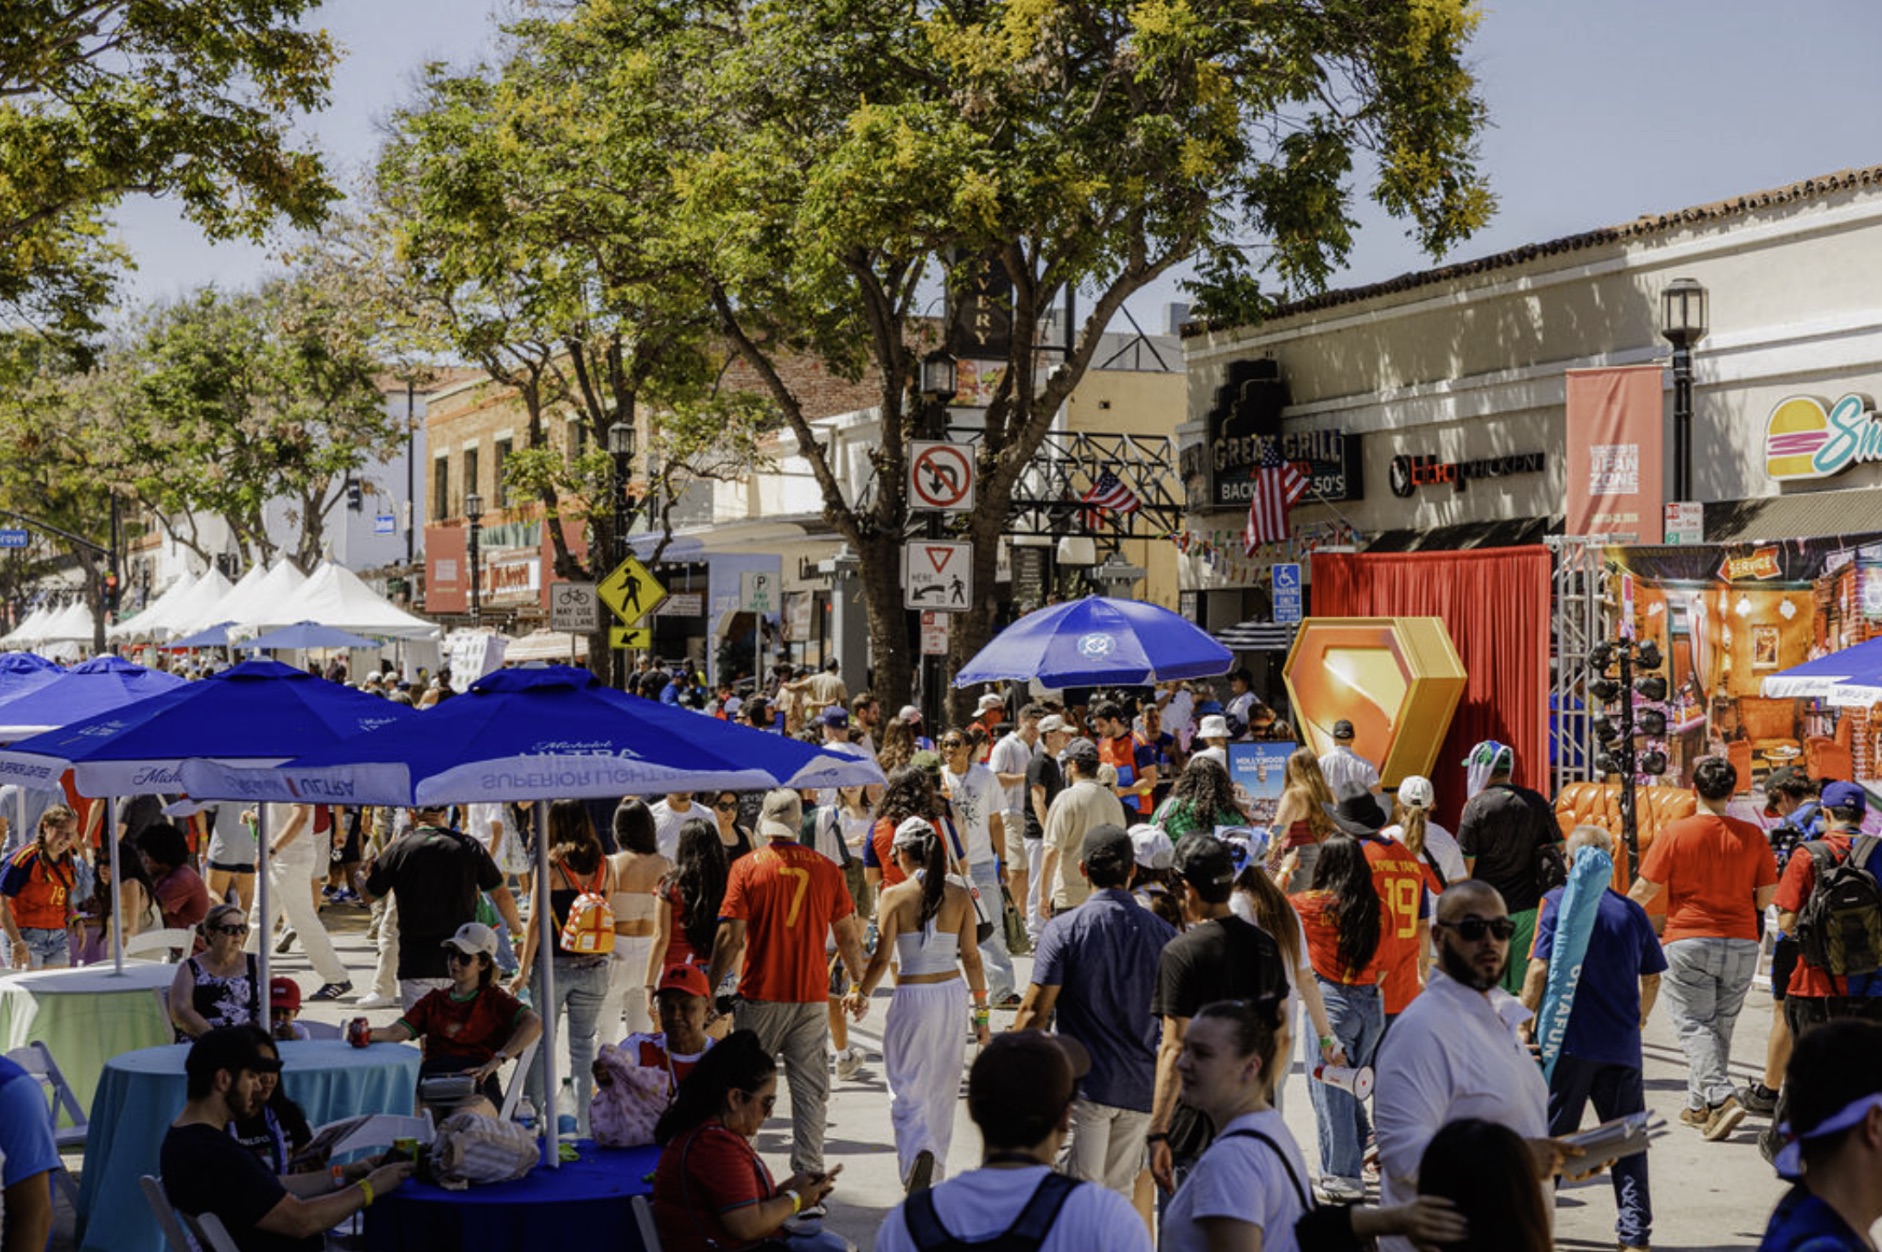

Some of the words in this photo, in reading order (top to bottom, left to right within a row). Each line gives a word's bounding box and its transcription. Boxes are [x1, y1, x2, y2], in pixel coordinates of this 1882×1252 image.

[1282, 428, 1341, 462] GRILL
[1814, 396, 1882, 472] Sm
[1460, 452, 1545, 479] CHICKEN
[1590, 472, 1638, 487] ZONE
[1729, 555, 1771, 574] SERVICE
[556, 607, 572, 616] MAY
[577, 607, 591, 616] USE
[575, 618, 594, 627] LANE
[50, 885, 66, 906] 19
[778, 867, 809, 927] 7
[1384, 878, 1418, 938] 19
